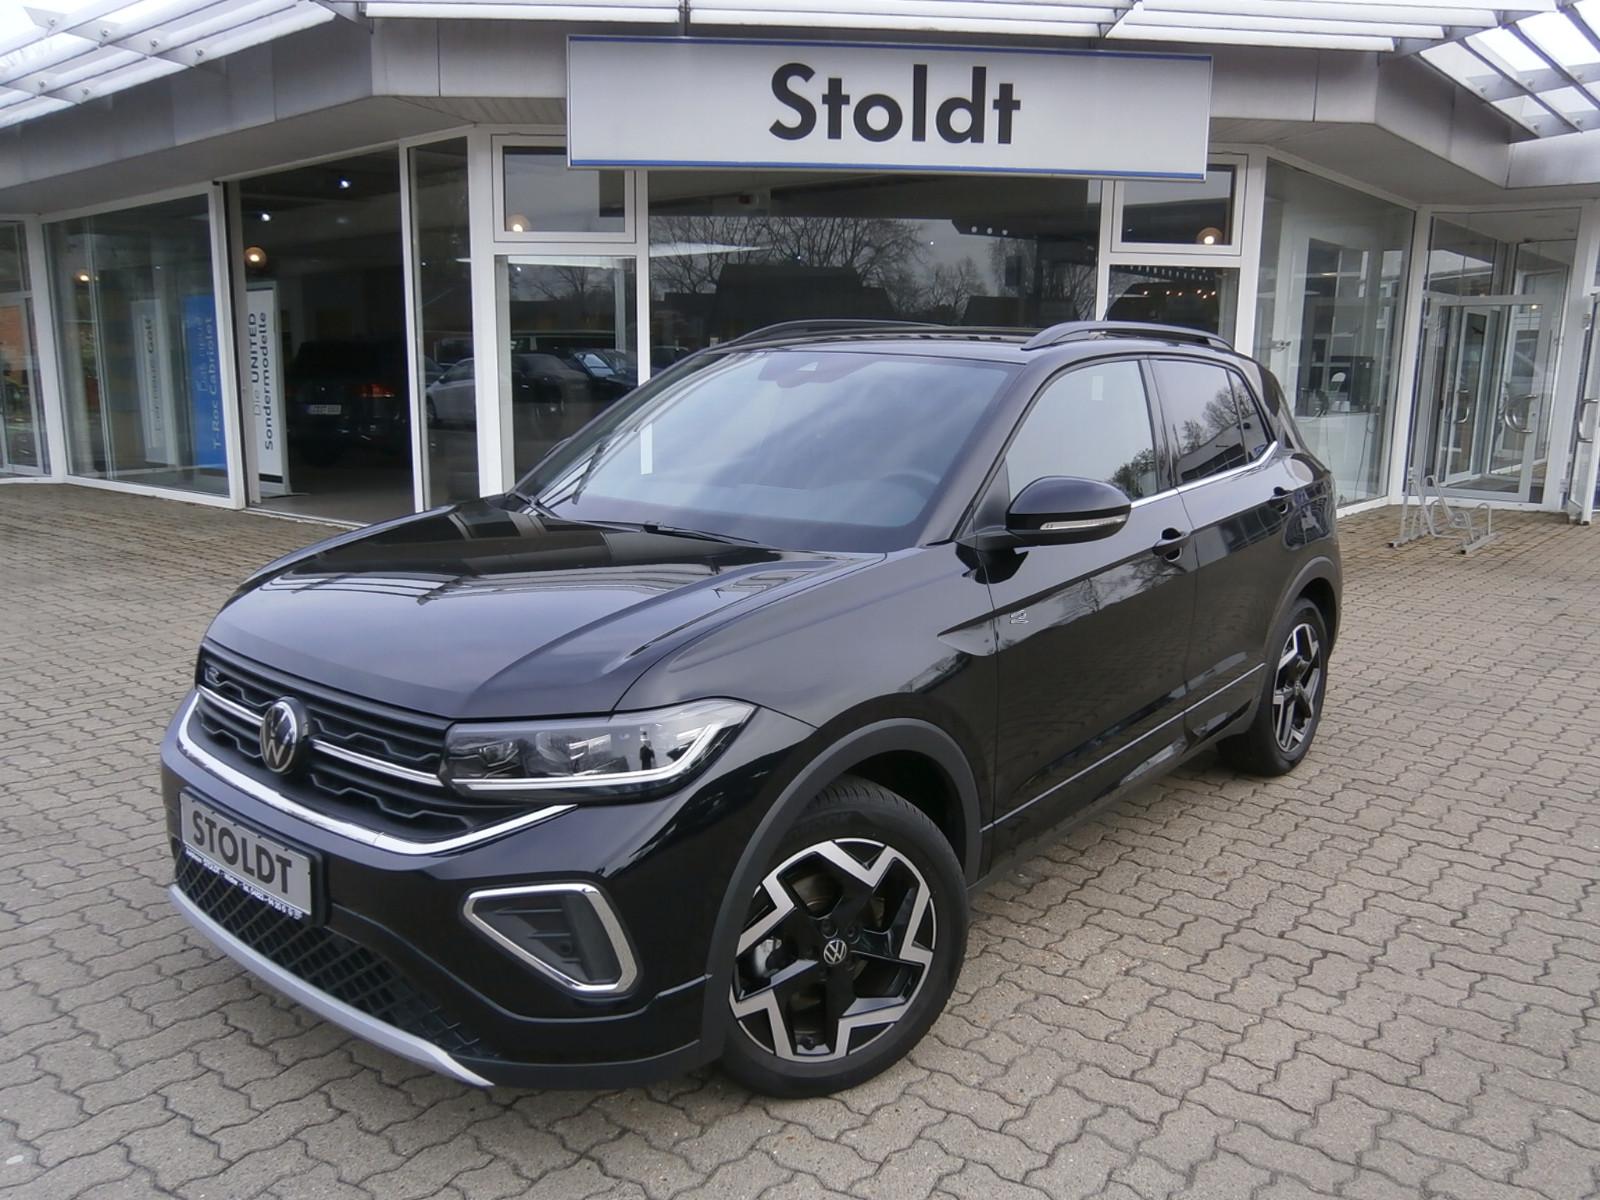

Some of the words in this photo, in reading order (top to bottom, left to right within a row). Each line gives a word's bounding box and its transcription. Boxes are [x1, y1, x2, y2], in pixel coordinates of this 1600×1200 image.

[769, 62, 1021, 145] Stoldt
[205, 317, 217, 395] Cabriolet
[248, 312, 260, 384] UNITED
[258, 311, 274, 451] Sondermodelle
[211, 400, 222, 449] T-Roc
[253, 389, 262, 416] Die
[192, 809, 293, 895] STOLDT
